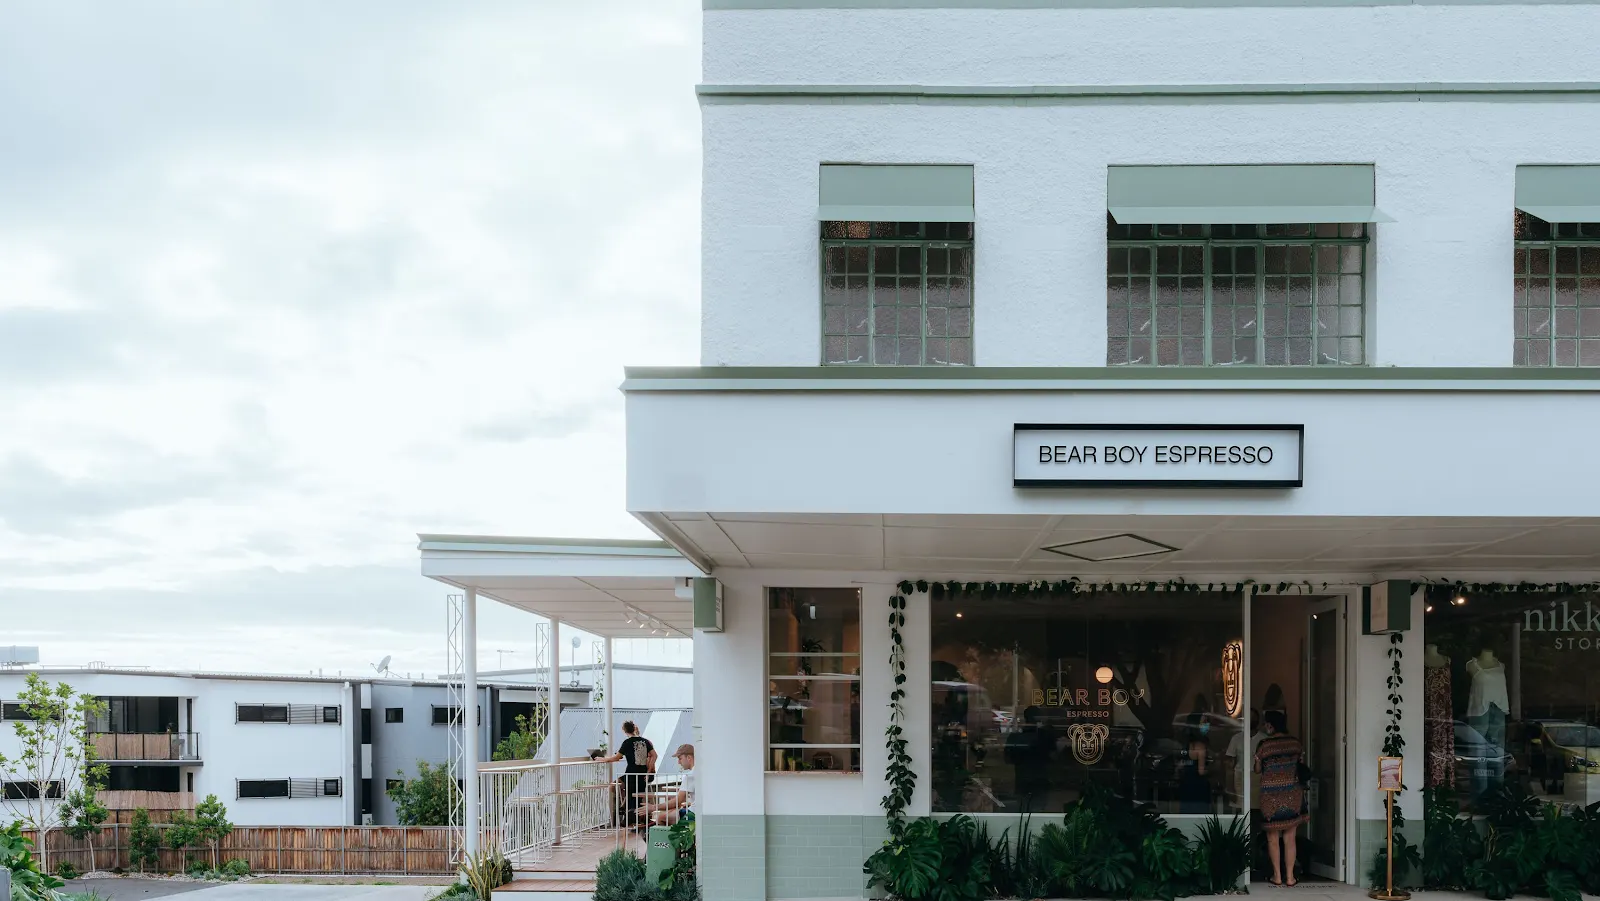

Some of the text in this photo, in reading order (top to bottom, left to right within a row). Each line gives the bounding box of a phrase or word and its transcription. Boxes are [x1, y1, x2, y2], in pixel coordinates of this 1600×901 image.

[1039, 445, 1273, 463] BEAR BOY ESPRESSO
[1031, 688, 1145, 706] BEAR BOY
[1066, 710, 1110, 718] ESPRESSO
